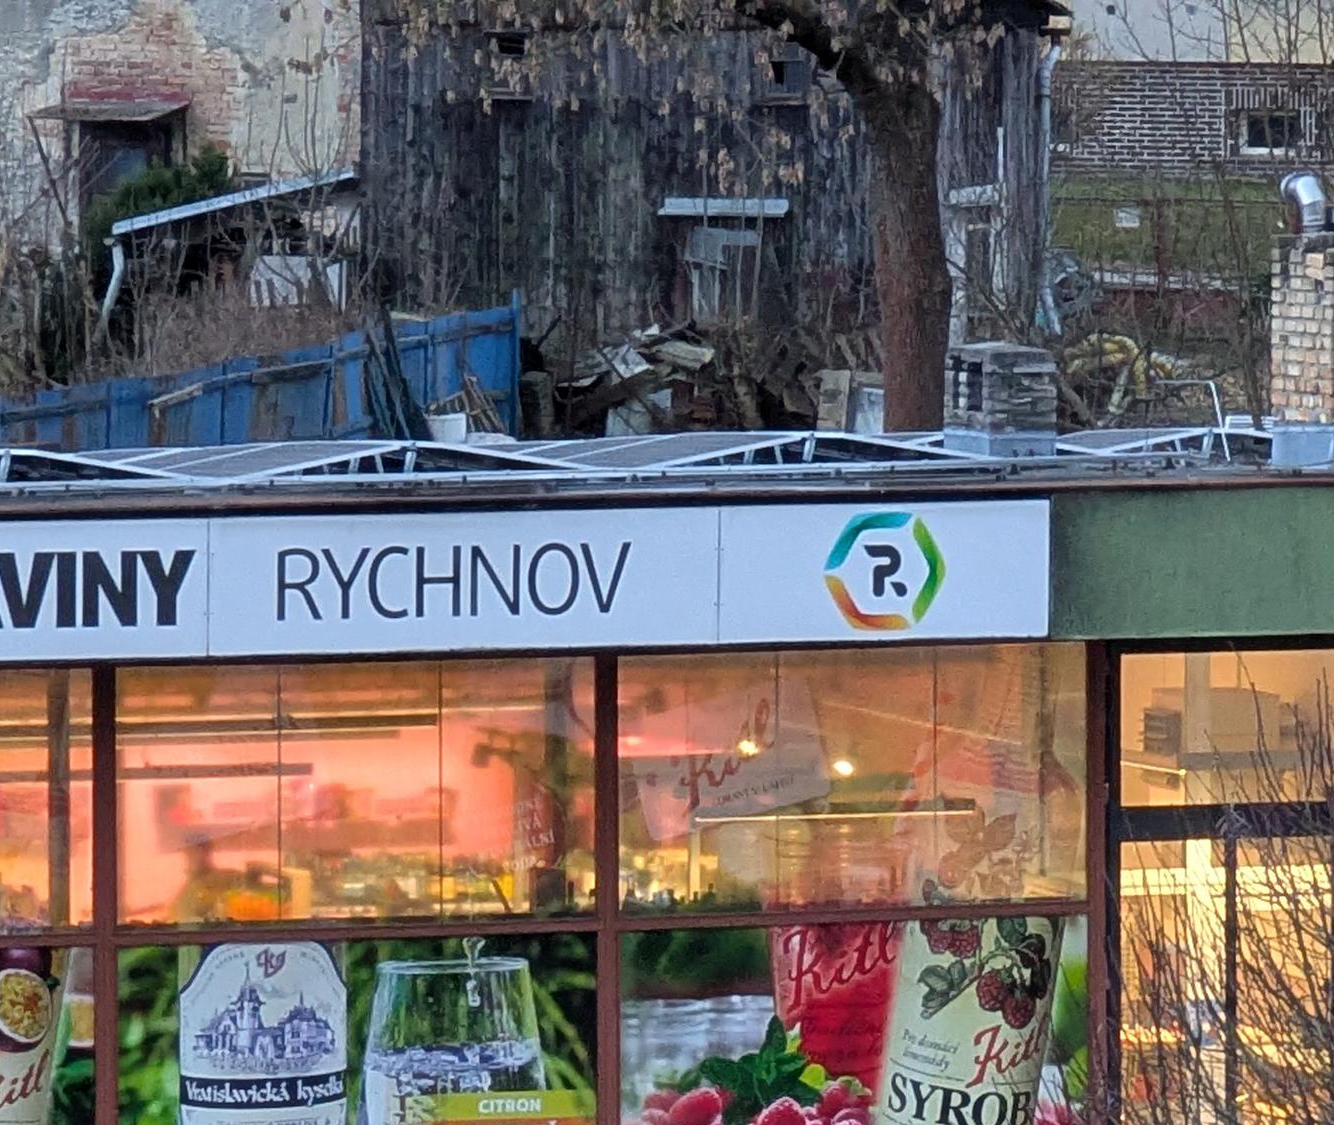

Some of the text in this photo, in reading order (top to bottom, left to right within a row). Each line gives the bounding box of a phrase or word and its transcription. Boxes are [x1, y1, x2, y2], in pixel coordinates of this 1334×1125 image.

[276, 541, 632, 621] RYCHNOV
[783, 921, 896, 1014] Kitl
[478, 1098, 541, 1113] CITRON
